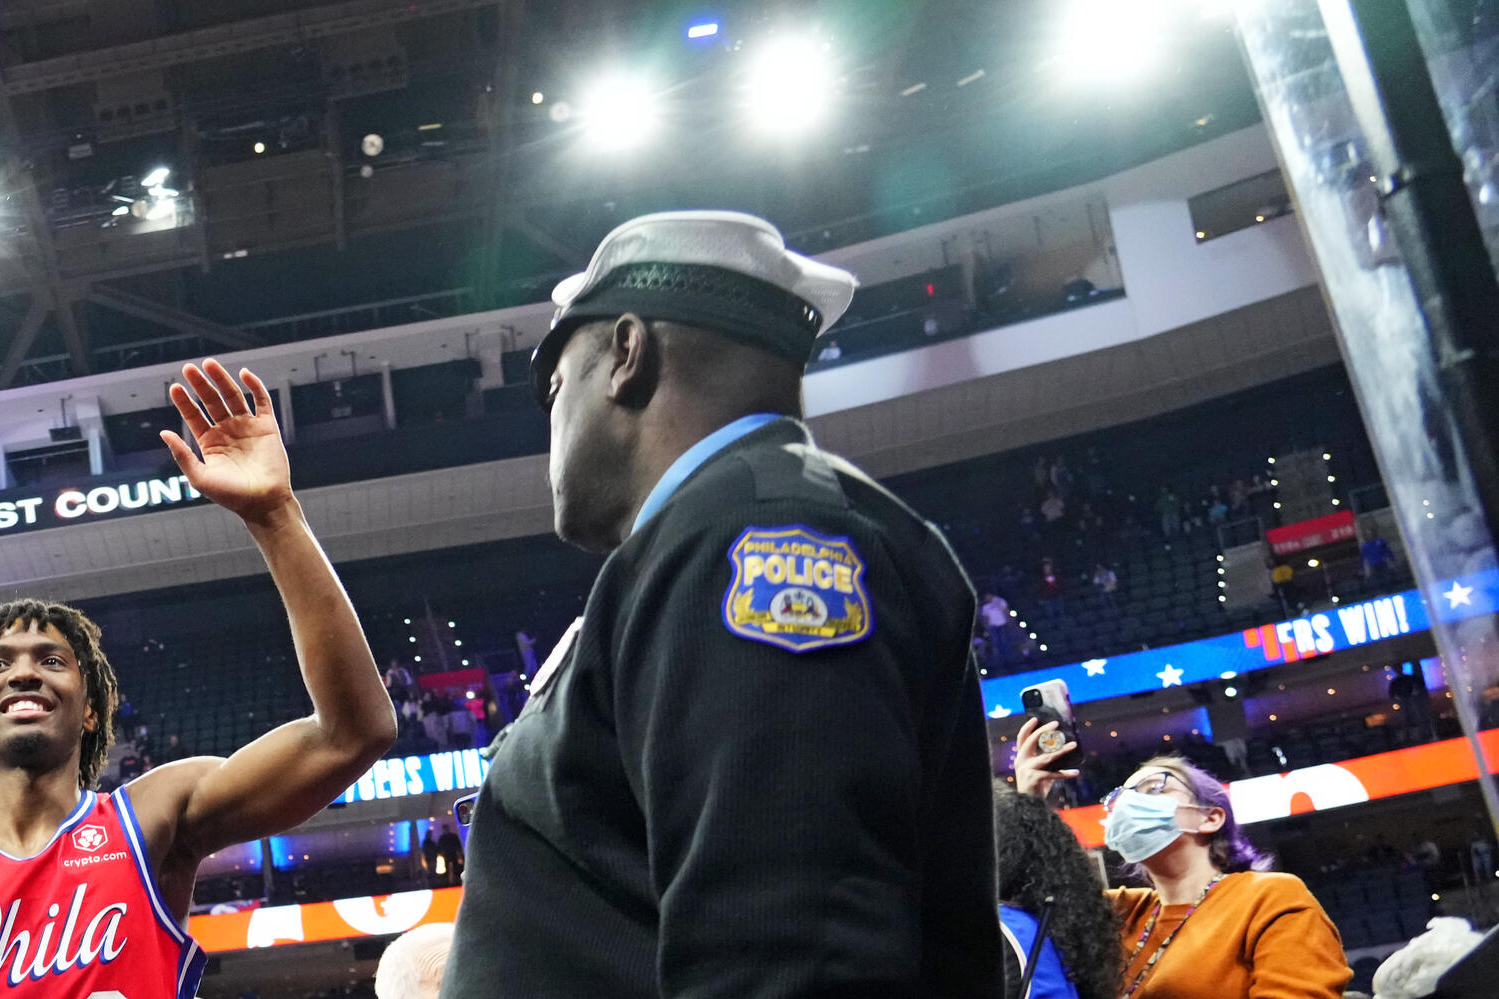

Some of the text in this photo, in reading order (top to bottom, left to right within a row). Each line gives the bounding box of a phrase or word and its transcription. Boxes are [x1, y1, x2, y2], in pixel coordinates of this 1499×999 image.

[743, 540, 852, 564] PHILADELPHIA
[743, 554, 854, 594] POLICE
[1338, 595, 1410, 645] WIN!
[63, 851, 127, 867] crypto.com
